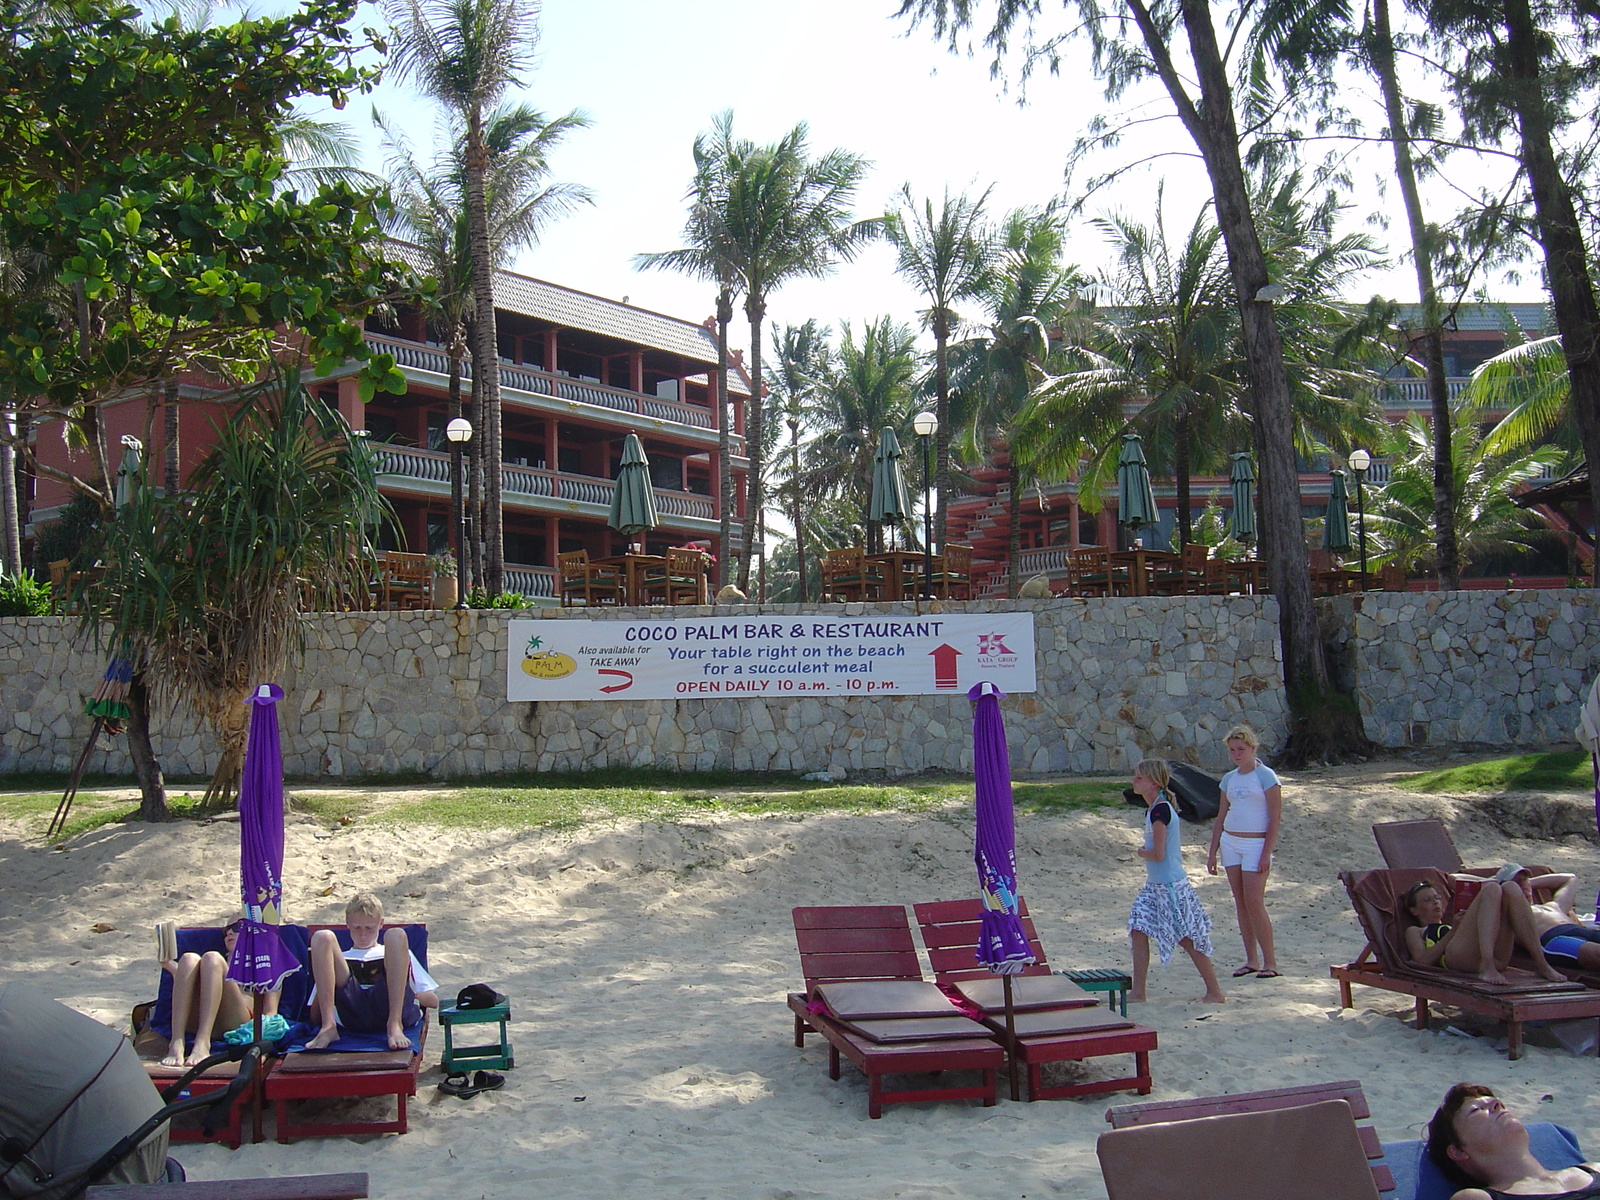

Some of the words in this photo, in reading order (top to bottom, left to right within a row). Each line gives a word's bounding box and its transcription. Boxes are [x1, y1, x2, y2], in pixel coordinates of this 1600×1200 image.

[625, 626, 677, 641] COCO
[685, 624, 738, 640] PALM
[744, 623, 783, 639] BAR
[789, 623, 806, 638] &
[812, 622, 944, 638] RESTAURANT
[578, 646, 596, 654] Also
[599, 645, 635, 654] available
[637, 645, 651, 654] for
[668, 647, 708, 660] Your
[711, 645, 752, 659] table
[757, 645, 797, 661] right
[802, 647, 821, 657] on
[828, 644, 853, 657] the
[858, 643, 905, 657] beach
[590, 658, 612, 667] TAKE
[614, 657, 641, 667] AWAY
[703, 662, 729, 675] for
[734, 664, 743, 675] a
[749, 661, 829, 674] succulent
[834, 660, 873, 673] meal
[676, 681, 720, 693] OPEN
[726, 679, 770, 692] DAILY
[777, 679, 793, 691] 10
[798, 681, 831, 691] a.m.
[846, 678, 862, 690] 10
[867, 680, 900, 692] p.m.
